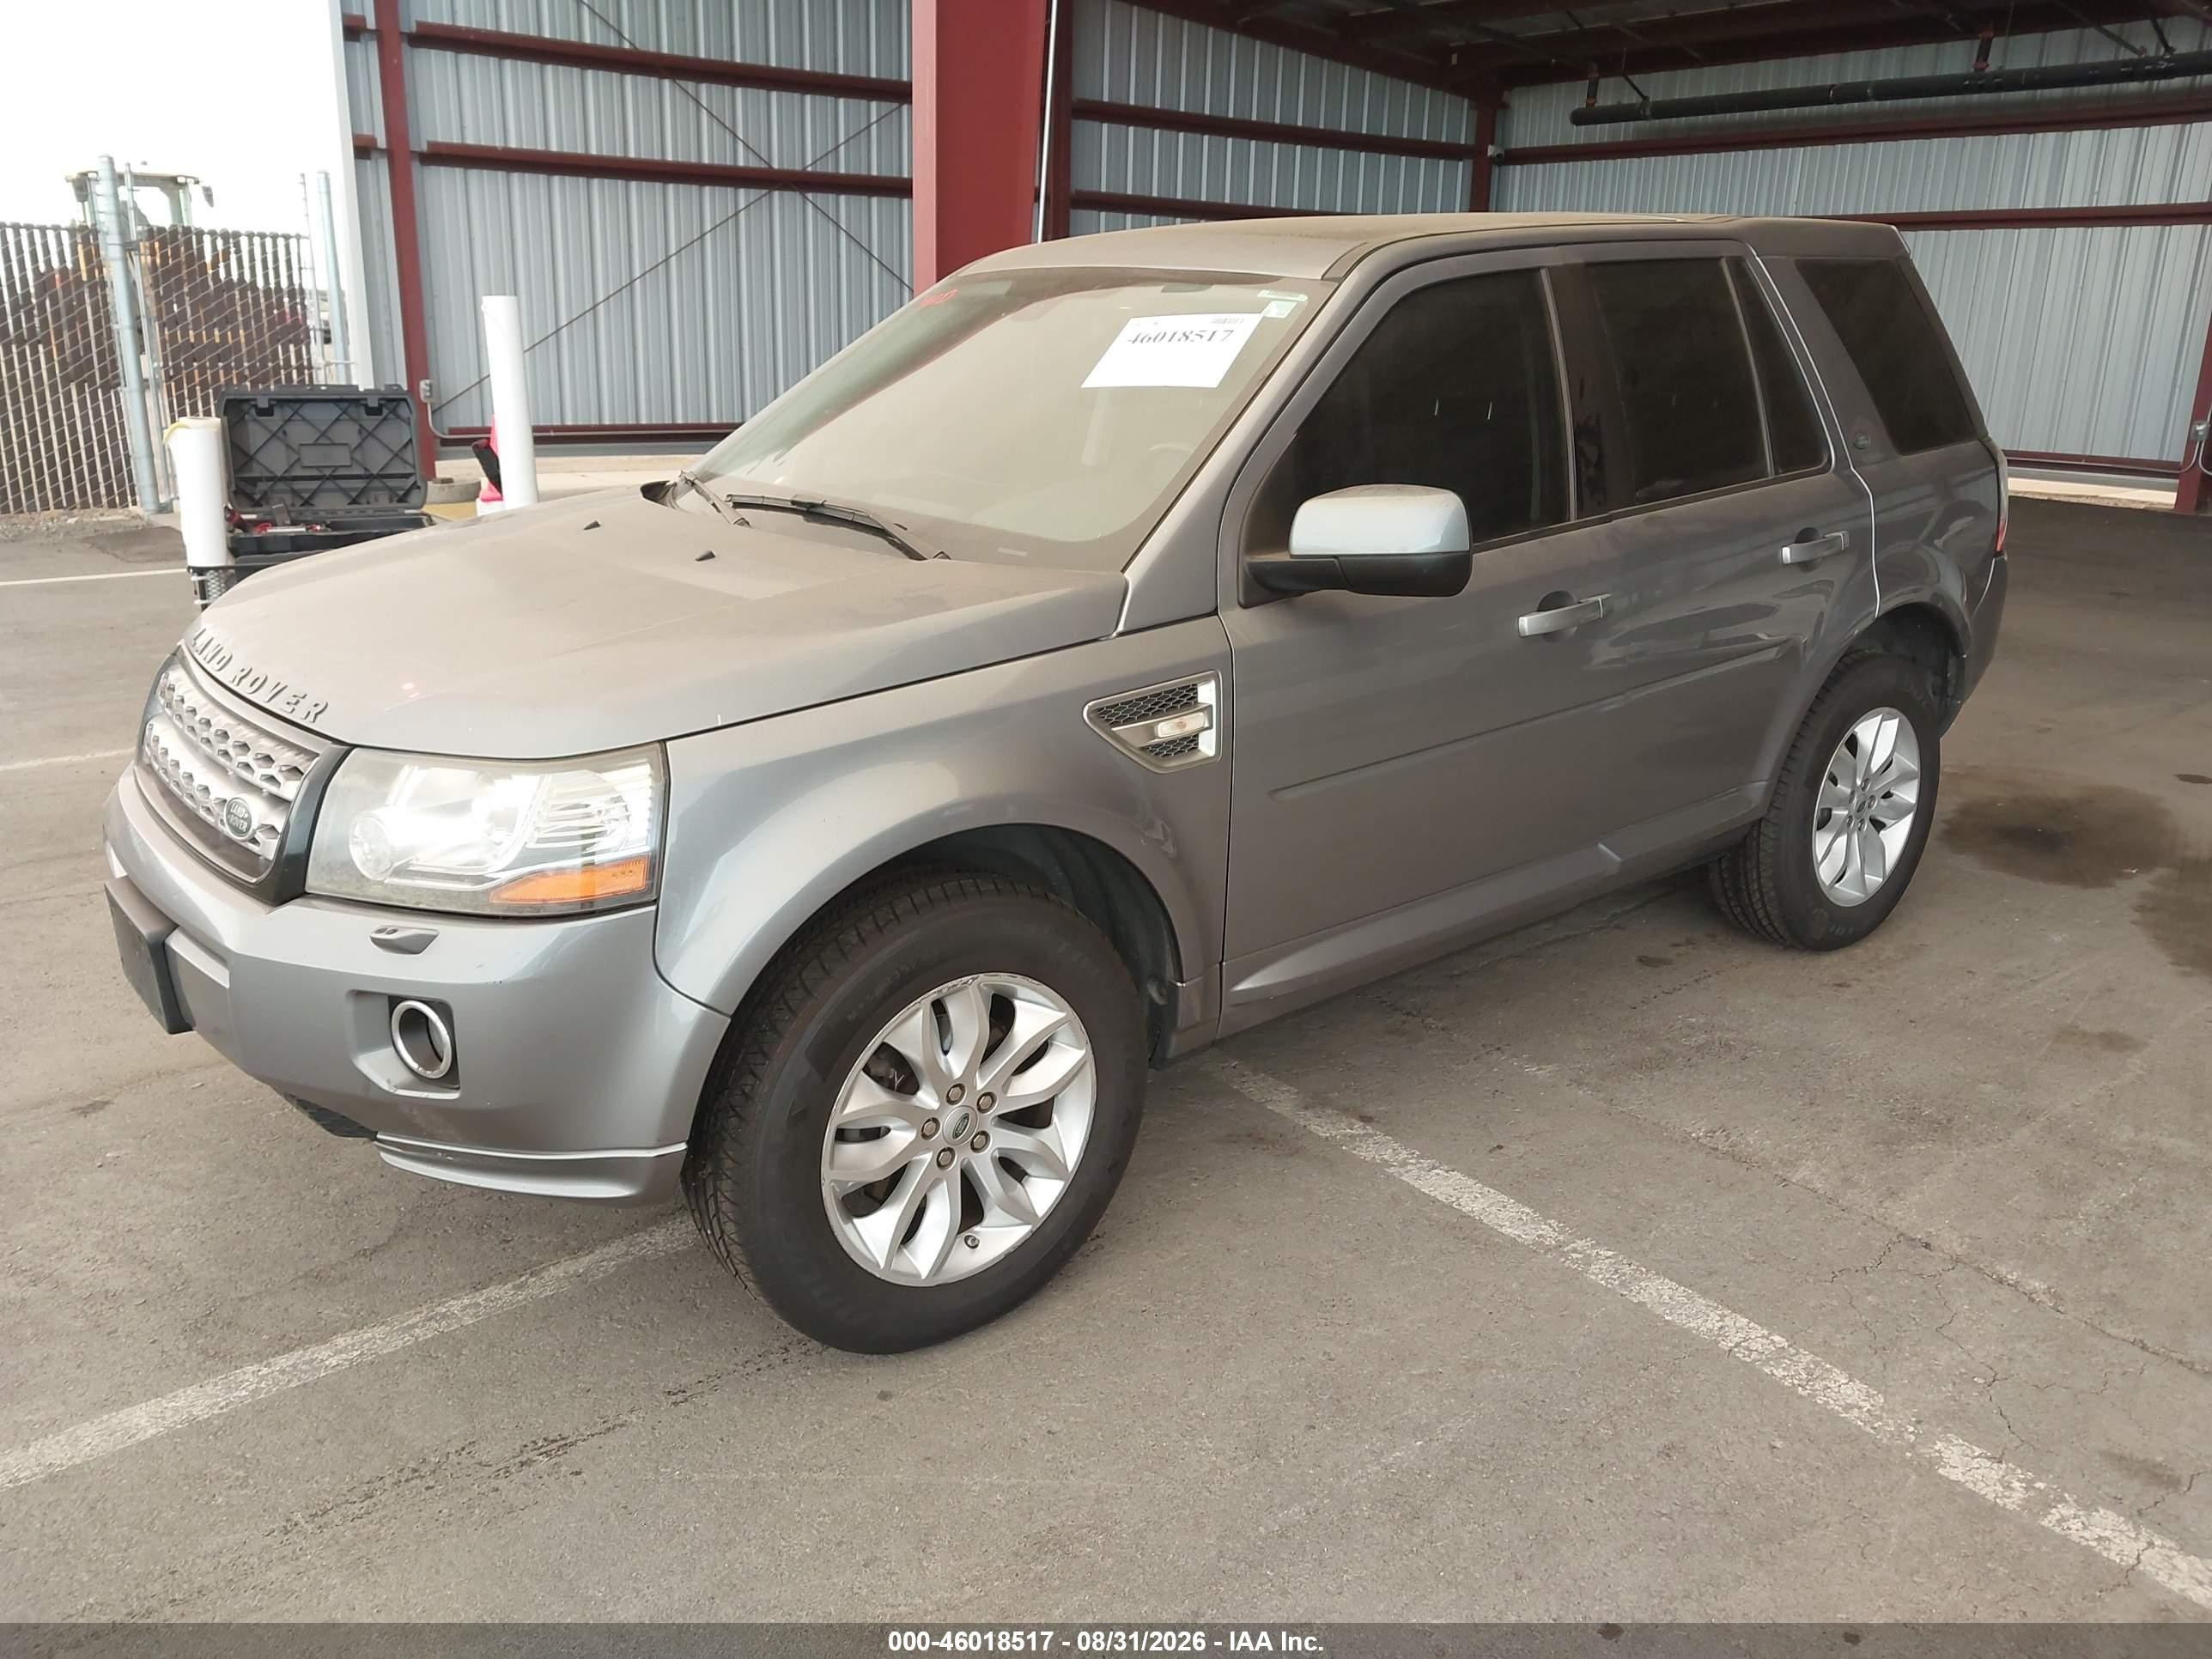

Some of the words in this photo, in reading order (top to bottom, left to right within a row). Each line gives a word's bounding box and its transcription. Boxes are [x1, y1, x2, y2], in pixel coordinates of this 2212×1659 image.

[1128, 329, 1234, 343] 46018517
[192, 628, 233, 672] LAND
[231, 667, 328, 722] ROVER
[230, 803, 246, 818] LAND
[228, 813, 248, 832] ROVER
